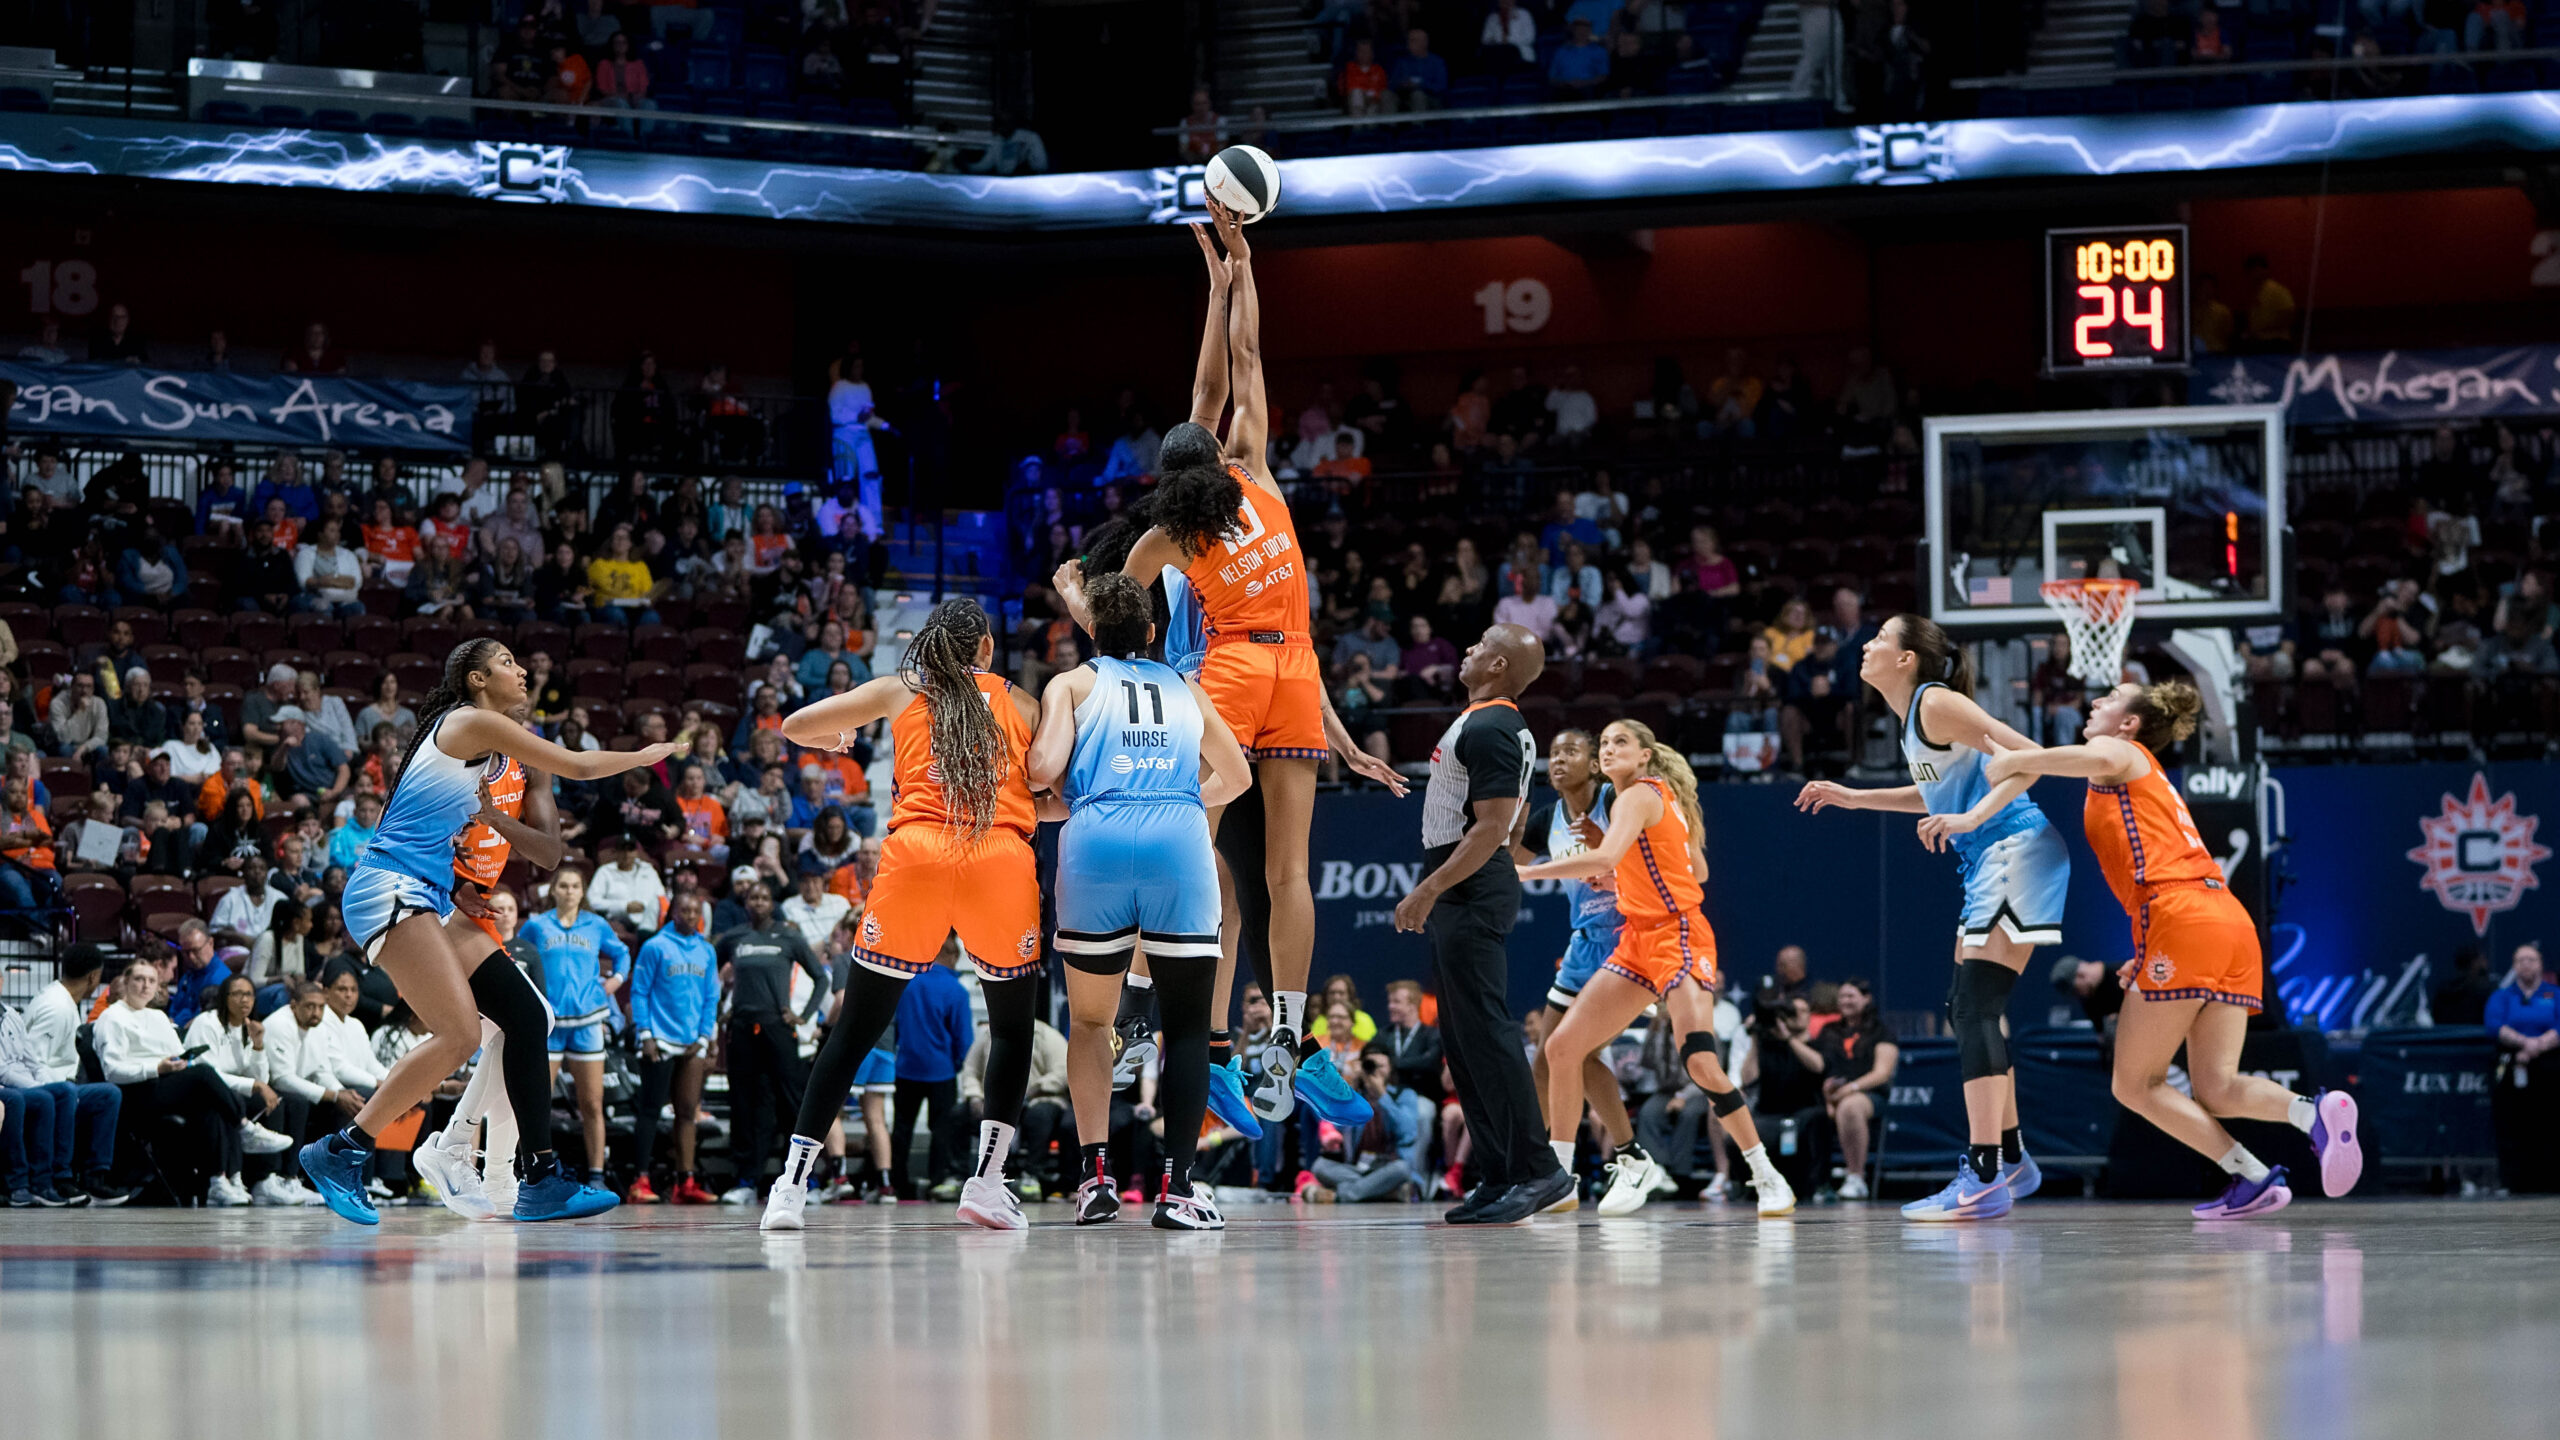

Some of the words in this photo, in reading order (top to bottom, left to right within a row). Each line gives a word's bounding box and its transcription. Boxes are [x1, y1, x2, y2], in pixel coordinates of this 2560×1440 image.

[2077, 239, 2175, 283] 10:00
[21, 259, 99, 314] 18
[1475, 278, 1551, 333] 19
[2075, 285, 2164, 357] 24
[2284, 352, 2542, 419] Mohegan
[141, 376, 258, 431] Sun
[270, 379, 456, 442] Arena
[1265, 562, 1294, 588] AT&T
[1121, 679, 1164, 725] 11
[1122, 730, 1168, 748] NURSE
[1135, 757, 1177, 770] AT&T
[2188, 766, 2247, 799] ally
[475, 854, 491, 862] Yale
[1316, 861, 1425, 899] BON
[1889, 1086, 1935, 1106] EEN
[2404, 1071, 2450, 1093] LUX
